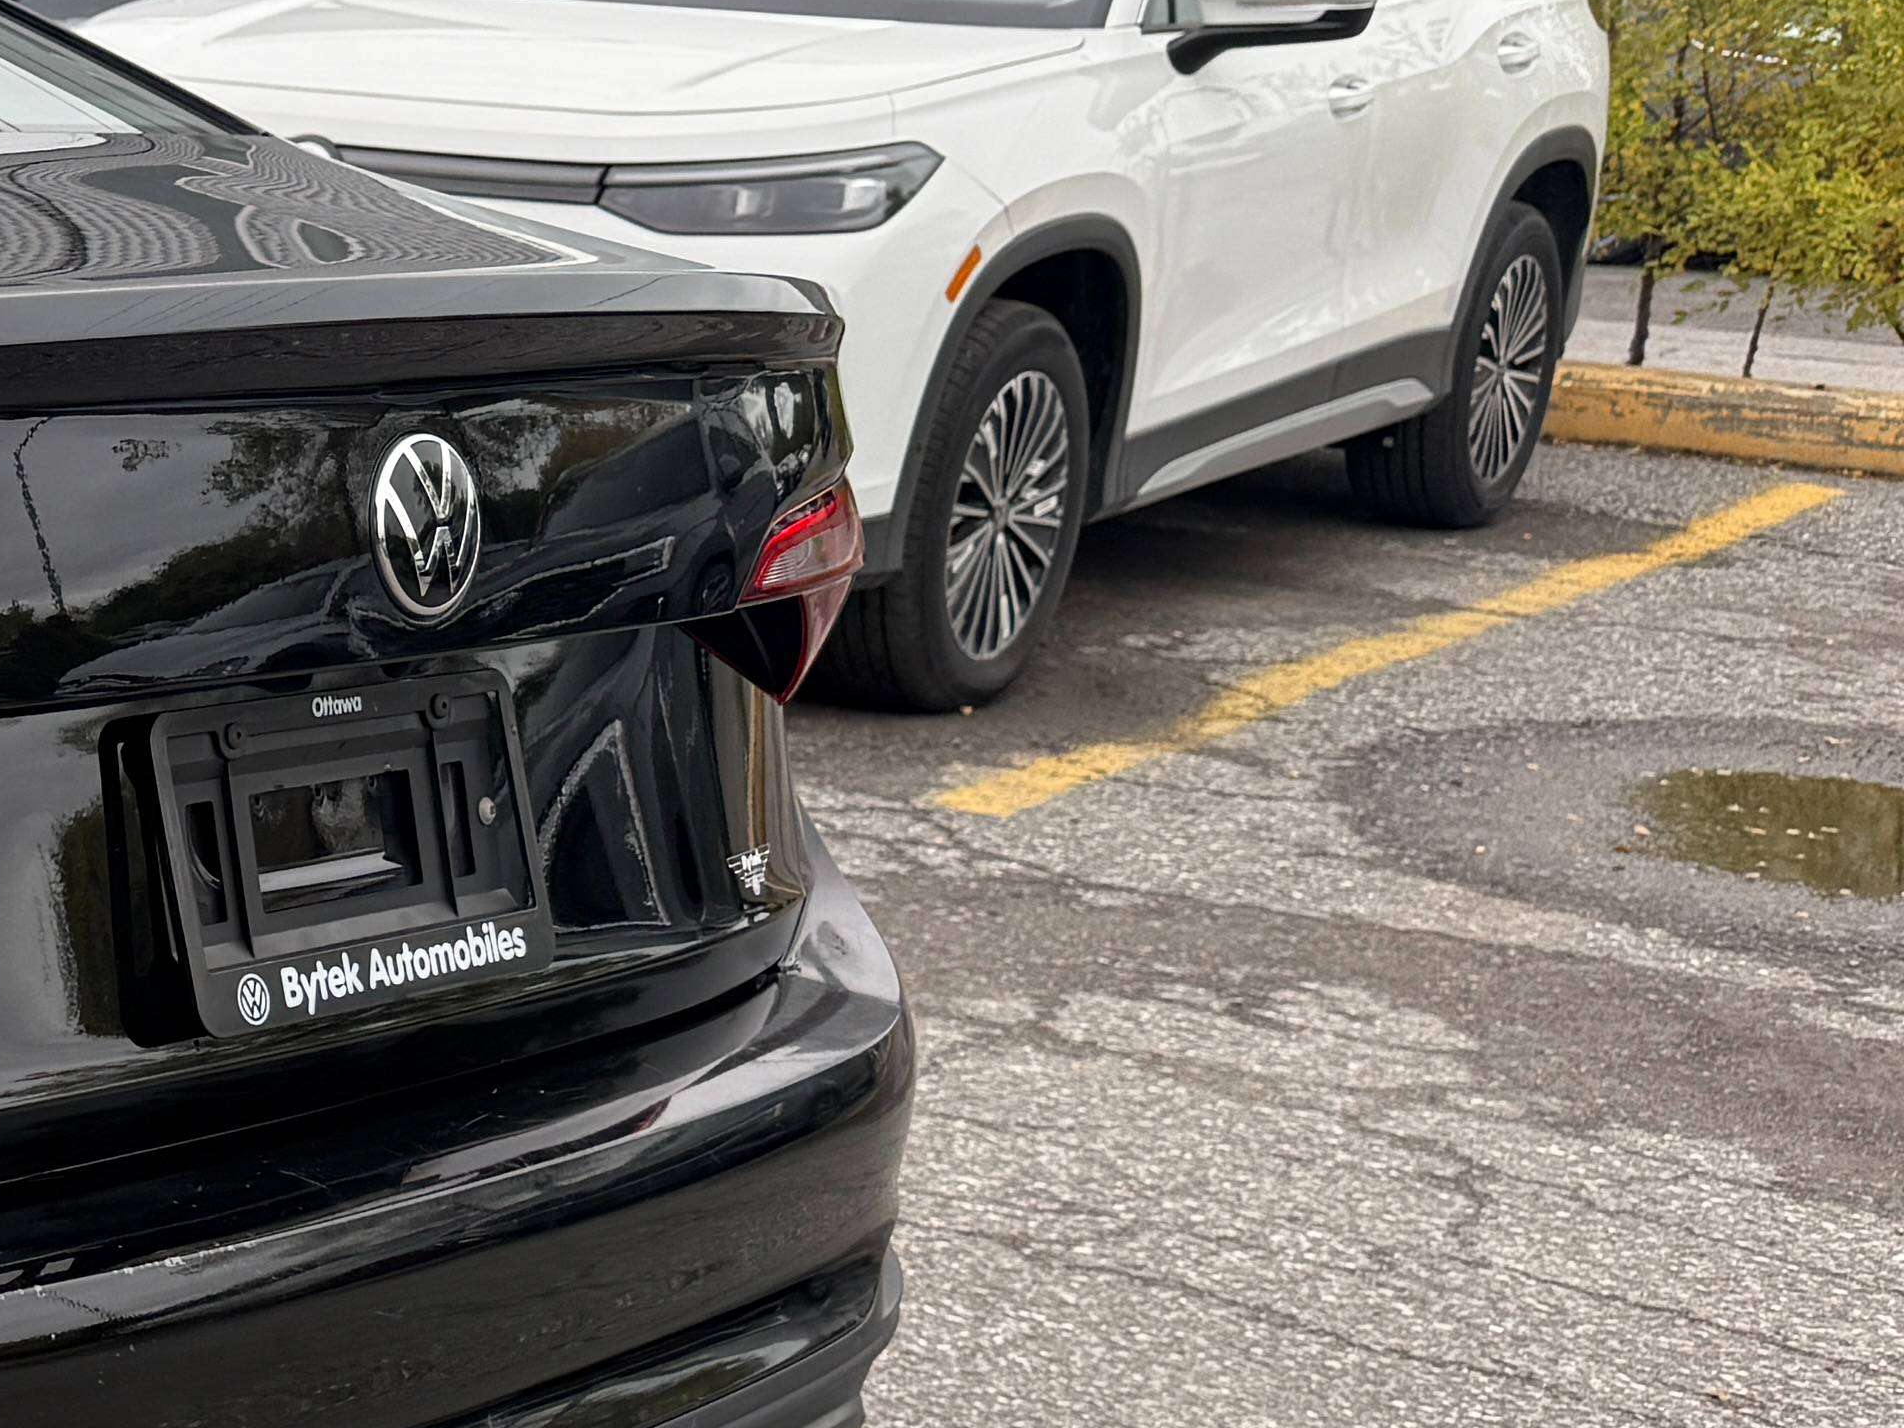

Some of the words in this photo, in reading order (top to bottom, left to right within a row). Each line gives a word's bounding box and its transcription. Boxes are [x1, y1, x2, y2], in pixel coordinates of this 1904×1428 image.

[311, 696, 362, 717] Ottawa
[280, 952, 363, 1015] Bytek
[369, 922, 527, 989] Automobiles
